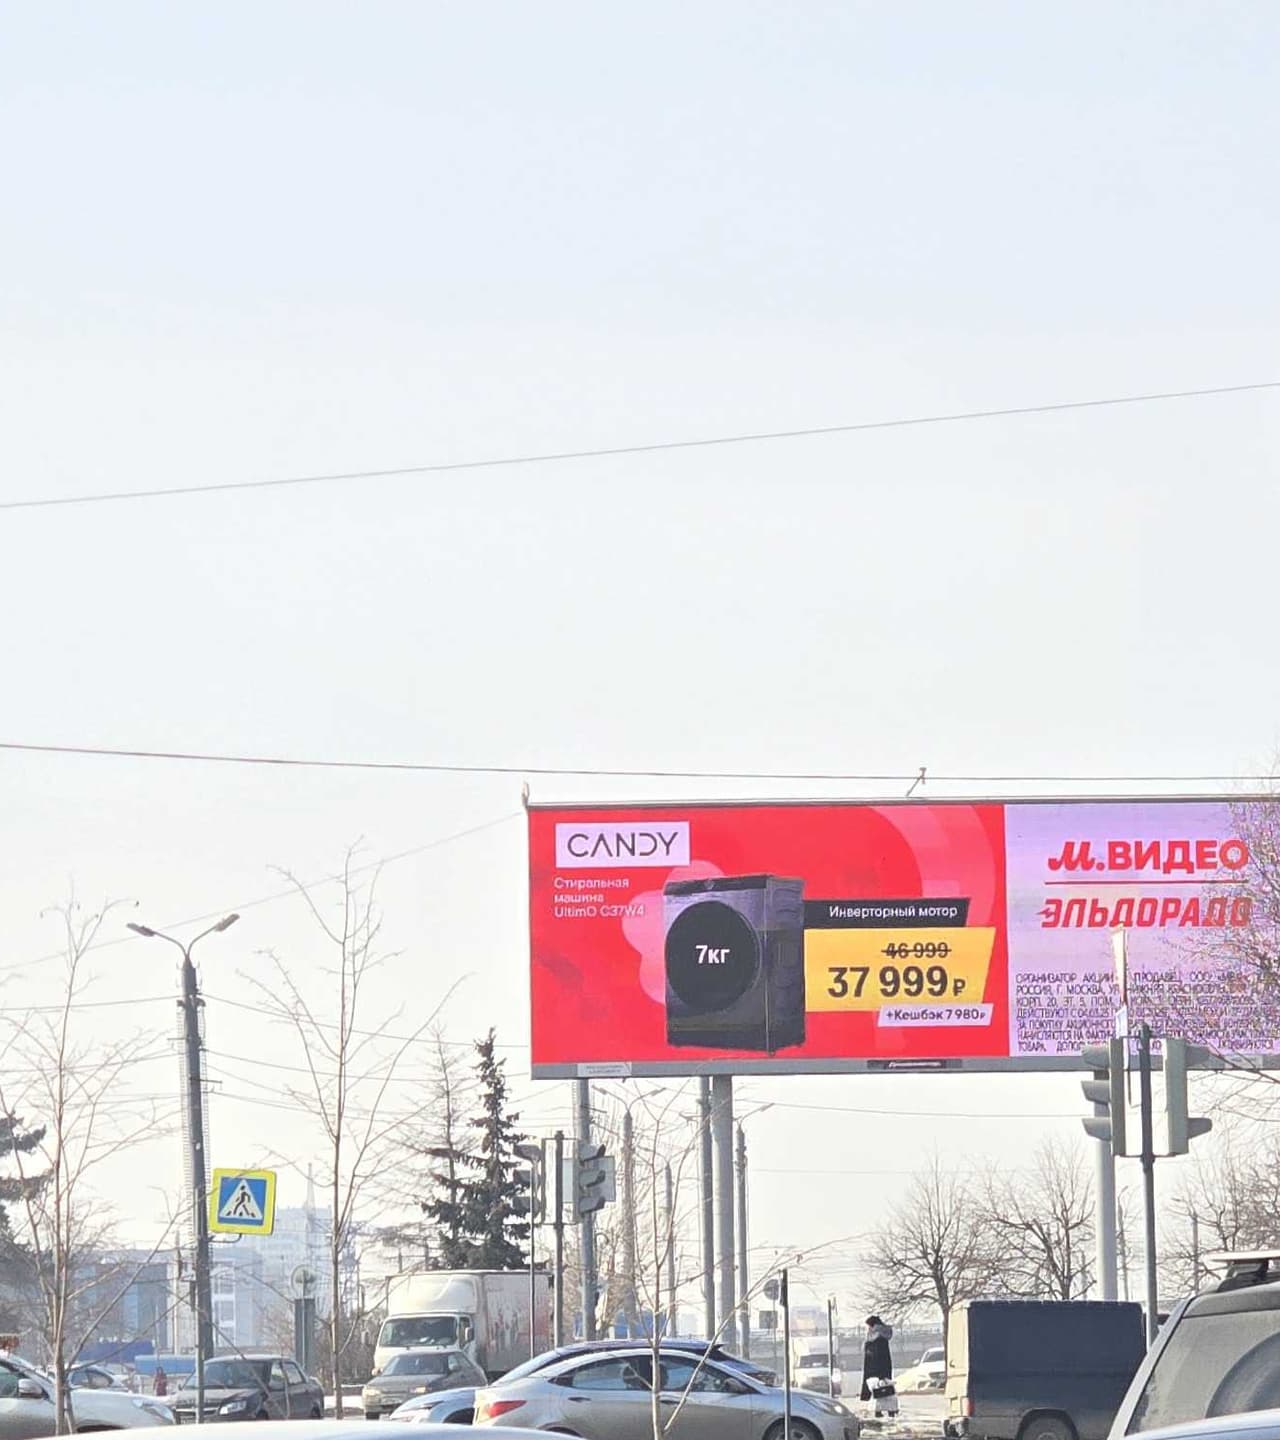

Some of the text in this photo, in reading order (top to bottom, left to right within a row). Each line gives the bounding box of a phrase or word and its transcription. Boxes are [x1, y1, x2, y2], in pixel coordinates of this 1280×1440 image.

[567, 832, 679, 857] CANDY
[1047, 839, 1250, 874] М.ВИДЕО
[553, 877, 630, 890] Стиральная
[553, 894, 604, 903] машина
[829, 905, 958, 919] Инверторный мотор
[1038, 897, 1253, 928] ЭЛЬДОРАДО
[695, 944, 731, 964] 7кг
[827, 966, 871, 998] 37
[878, 965, 949, 997] 999
